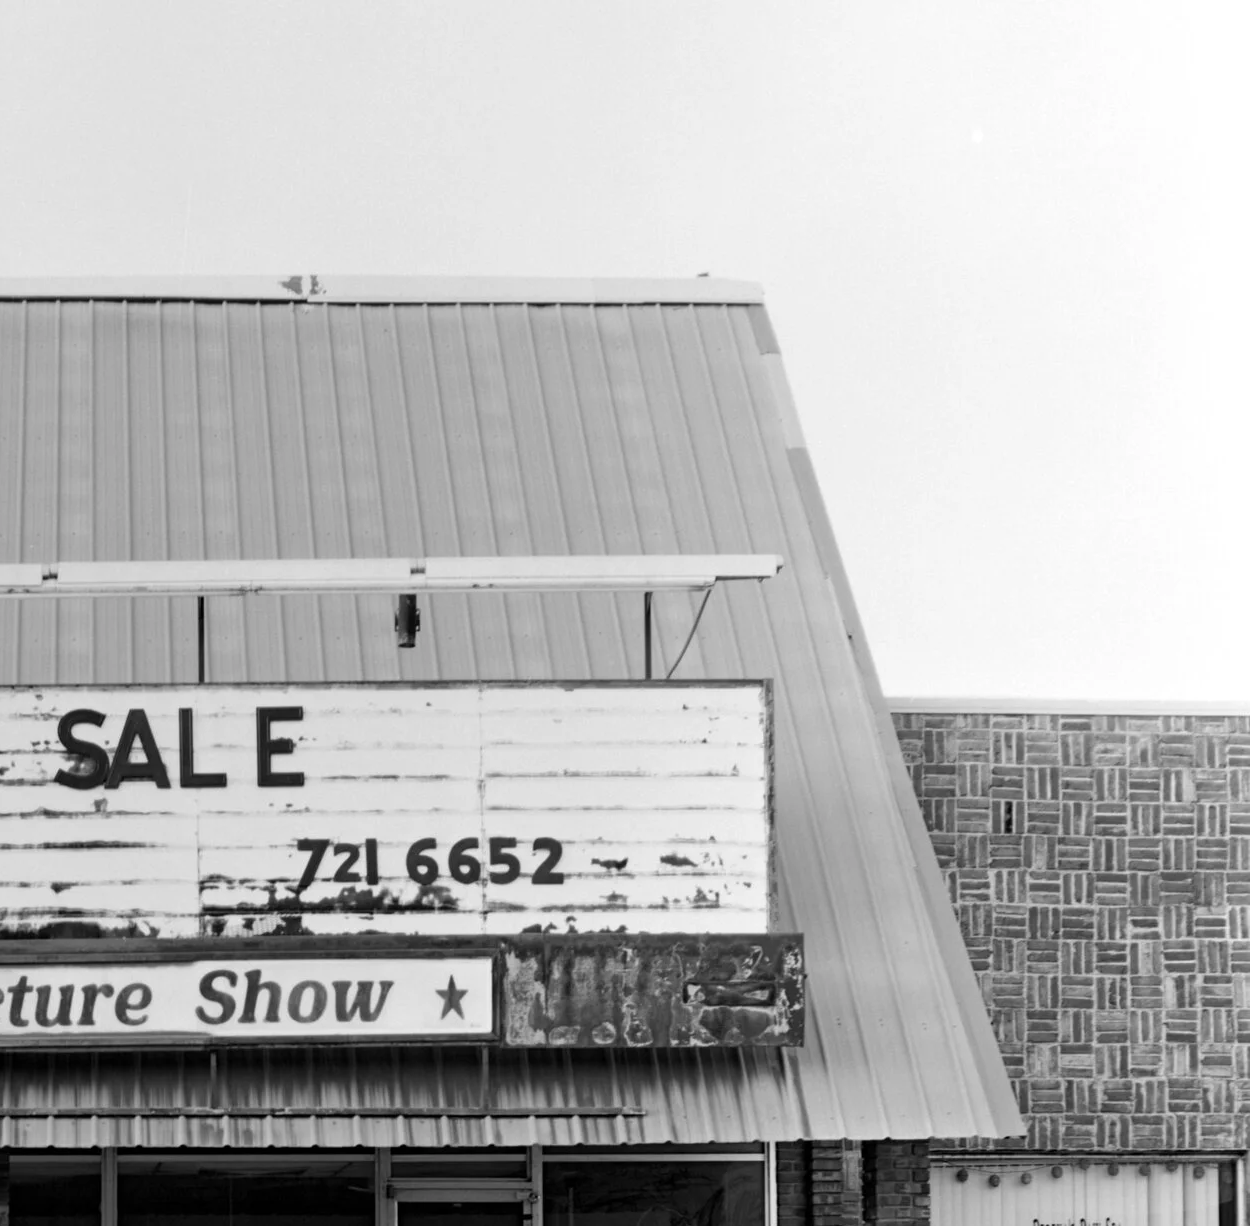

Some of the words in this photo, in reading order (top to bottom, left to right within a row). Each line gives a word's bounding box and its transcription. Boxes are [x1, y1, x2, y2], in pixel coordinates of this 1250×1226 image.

[53, 706, 306, 789] SALE
[296, 838, 379, 893] 721
[405, 836, 565, 885] 6652
[196, 969, 395, 1026] Show
